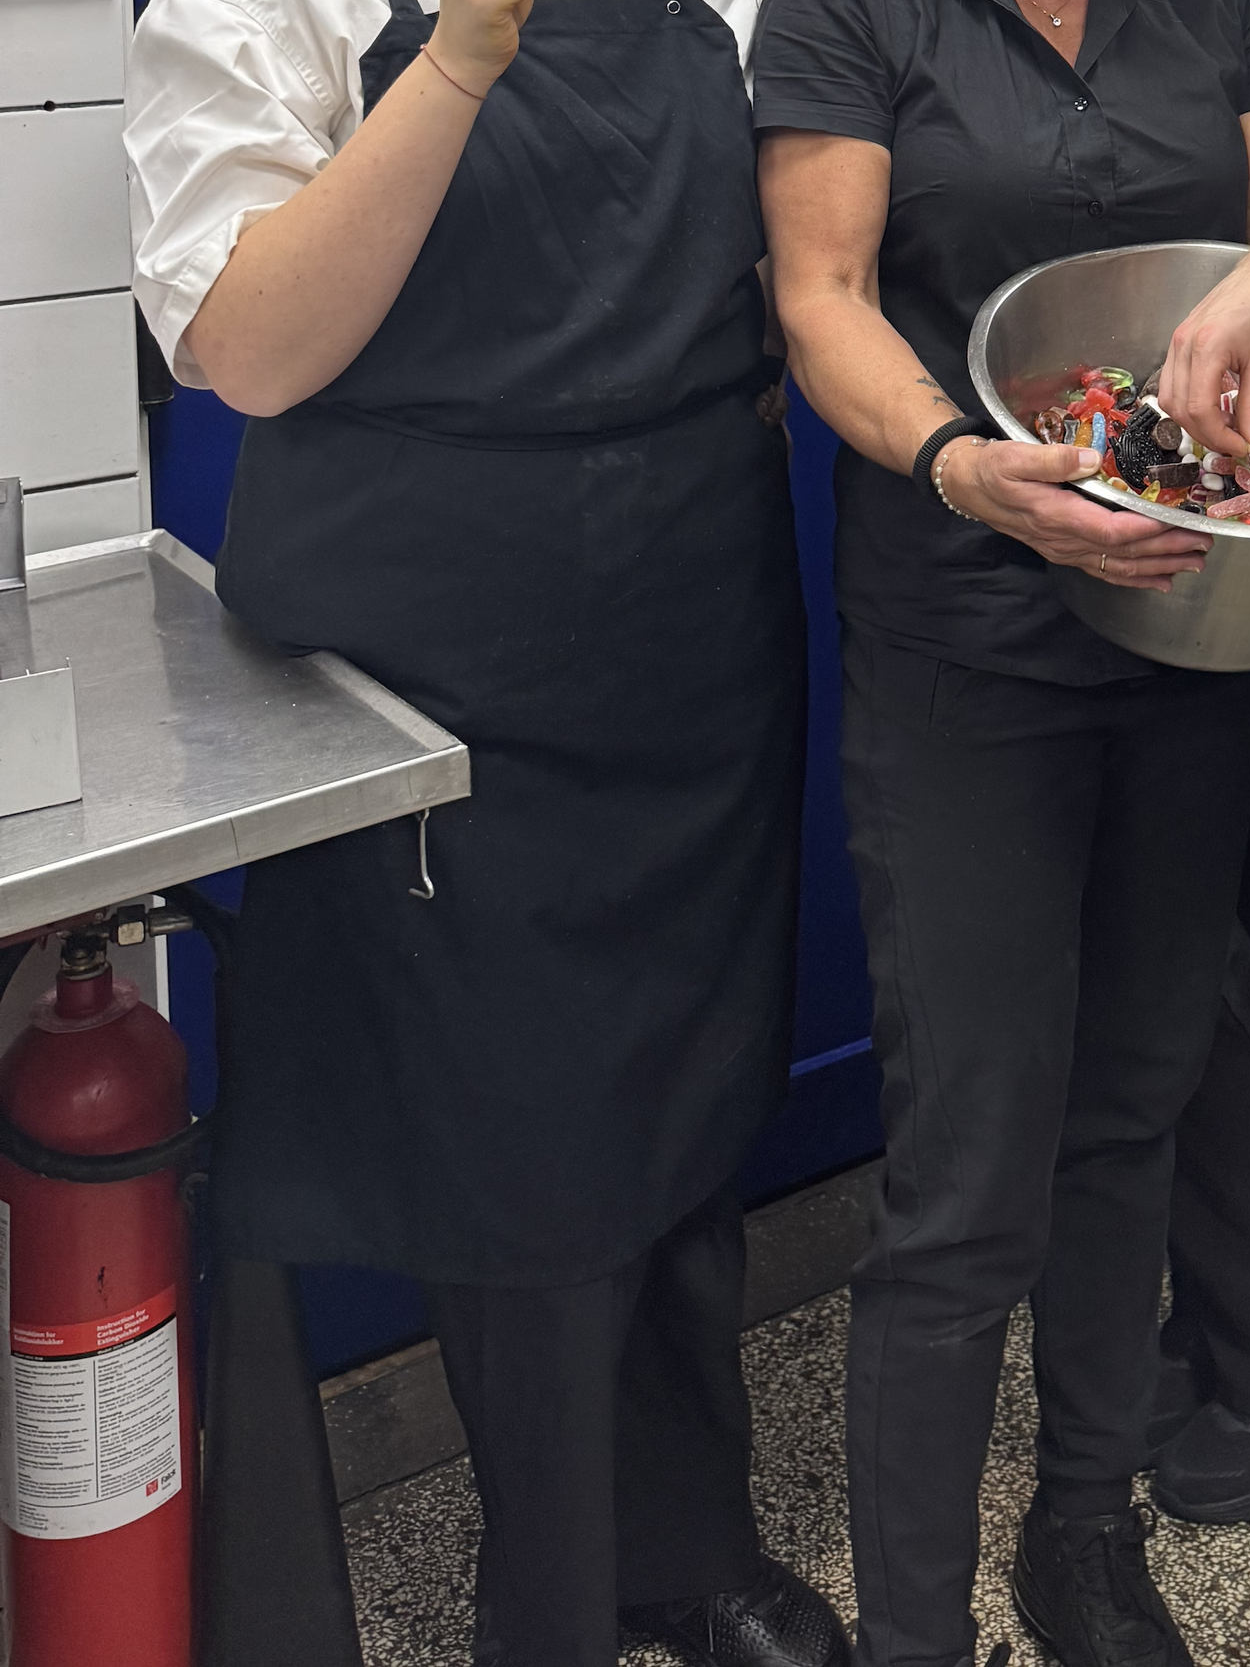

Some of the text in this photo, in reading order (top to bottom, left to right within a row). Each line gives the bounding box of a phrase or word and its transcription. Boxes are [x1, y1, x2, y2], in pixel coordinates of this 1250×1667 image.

[96, 1308, 147, 1332] Instruction for
[96, 1326, 123, 1339] Carbon
